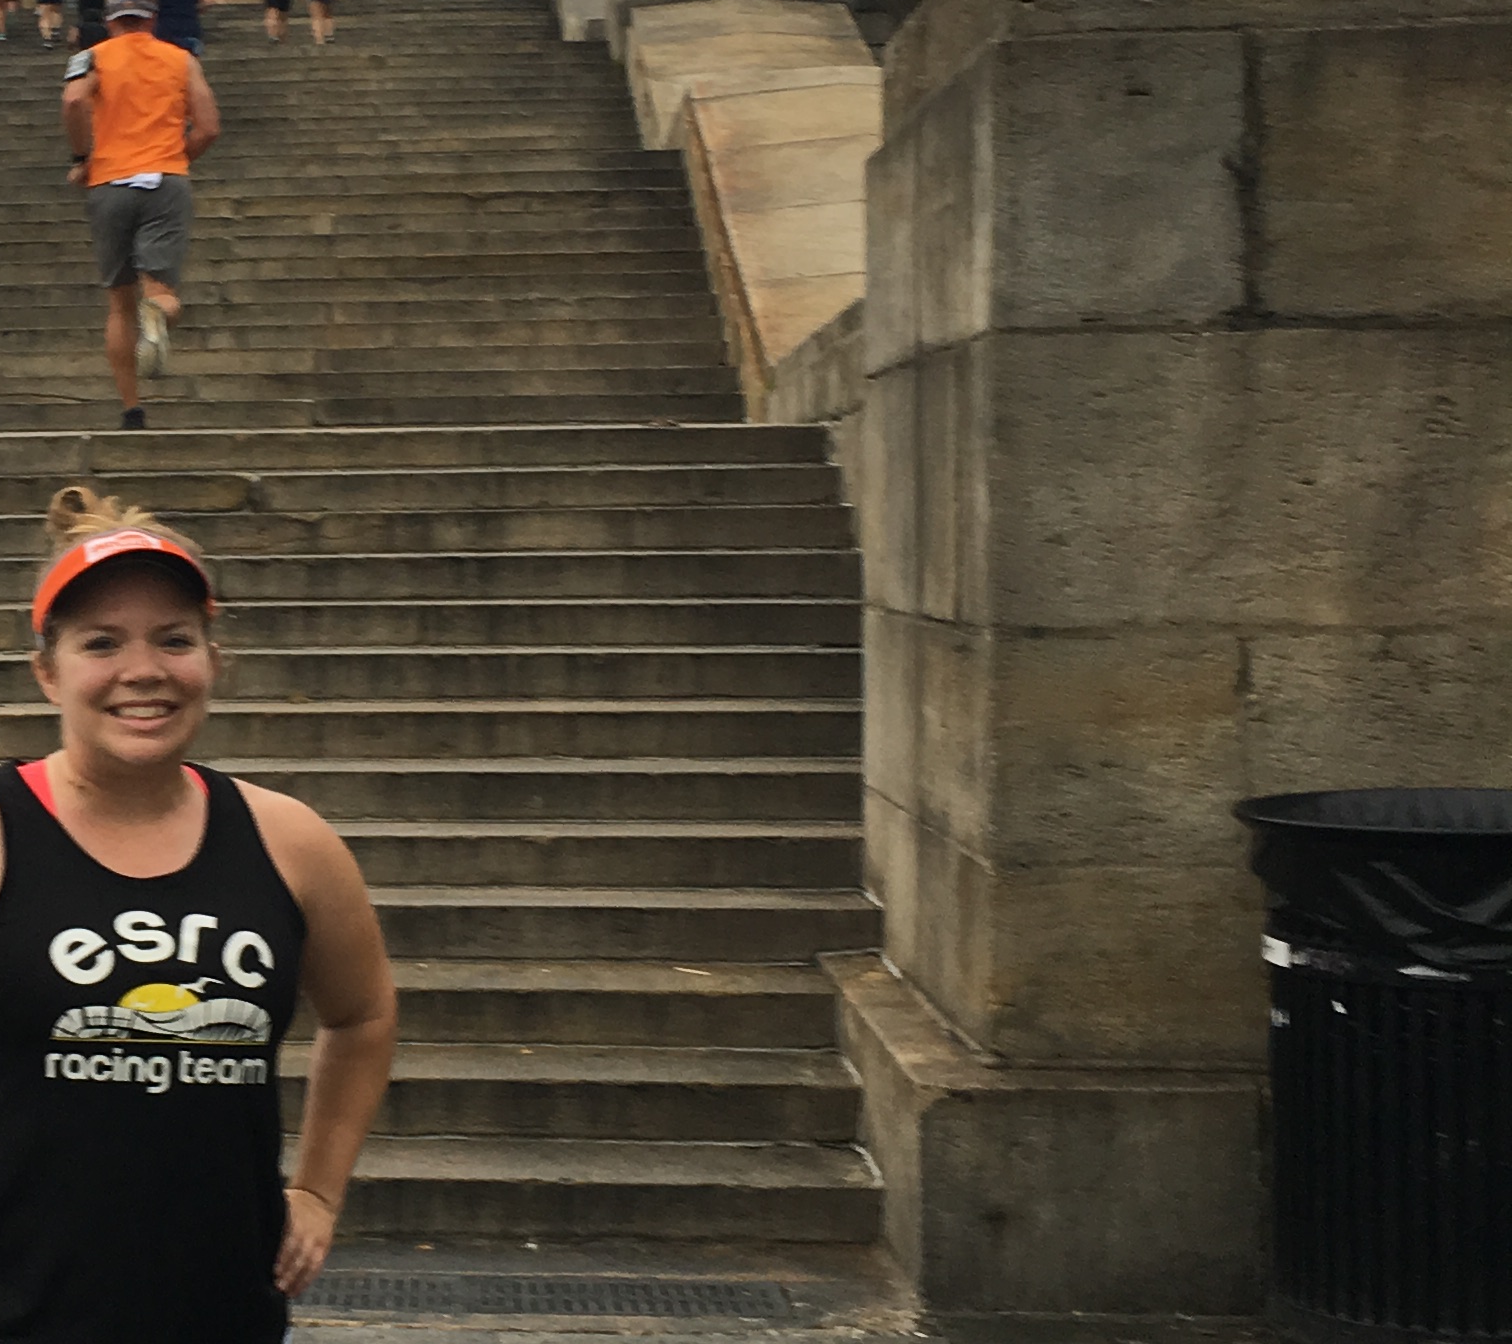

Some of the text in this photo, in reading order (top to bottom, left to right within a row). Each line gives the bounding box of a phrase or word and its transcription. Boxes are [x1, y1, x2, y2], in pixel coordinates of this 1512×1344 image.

[48, 910, 275, 988] esrc
[44, 1048, 268, 1093] racing team
